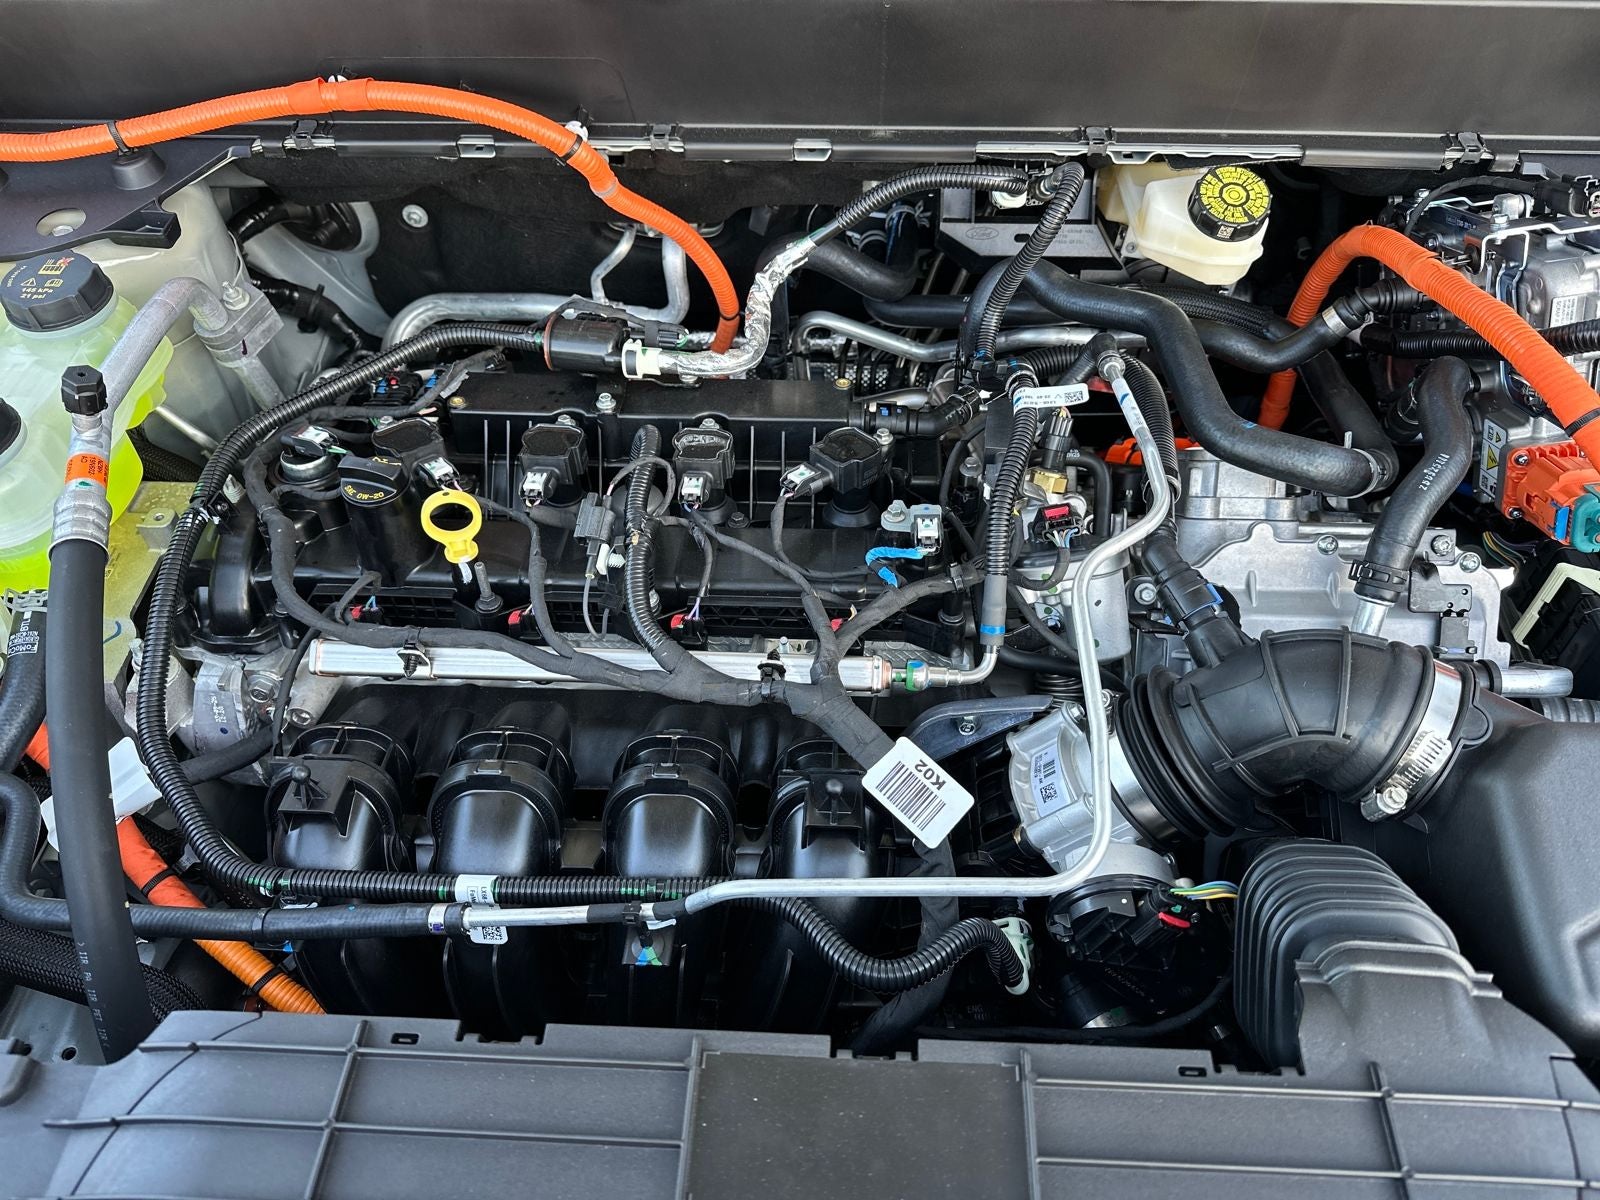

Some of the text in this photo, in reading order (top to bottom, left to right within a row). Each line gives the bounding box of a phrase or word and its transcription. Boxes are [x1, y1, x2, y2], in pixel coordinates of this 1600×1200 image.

[344, 484, 385, 500] SAE 0W-20
[914, 758, 947, 790] K02
